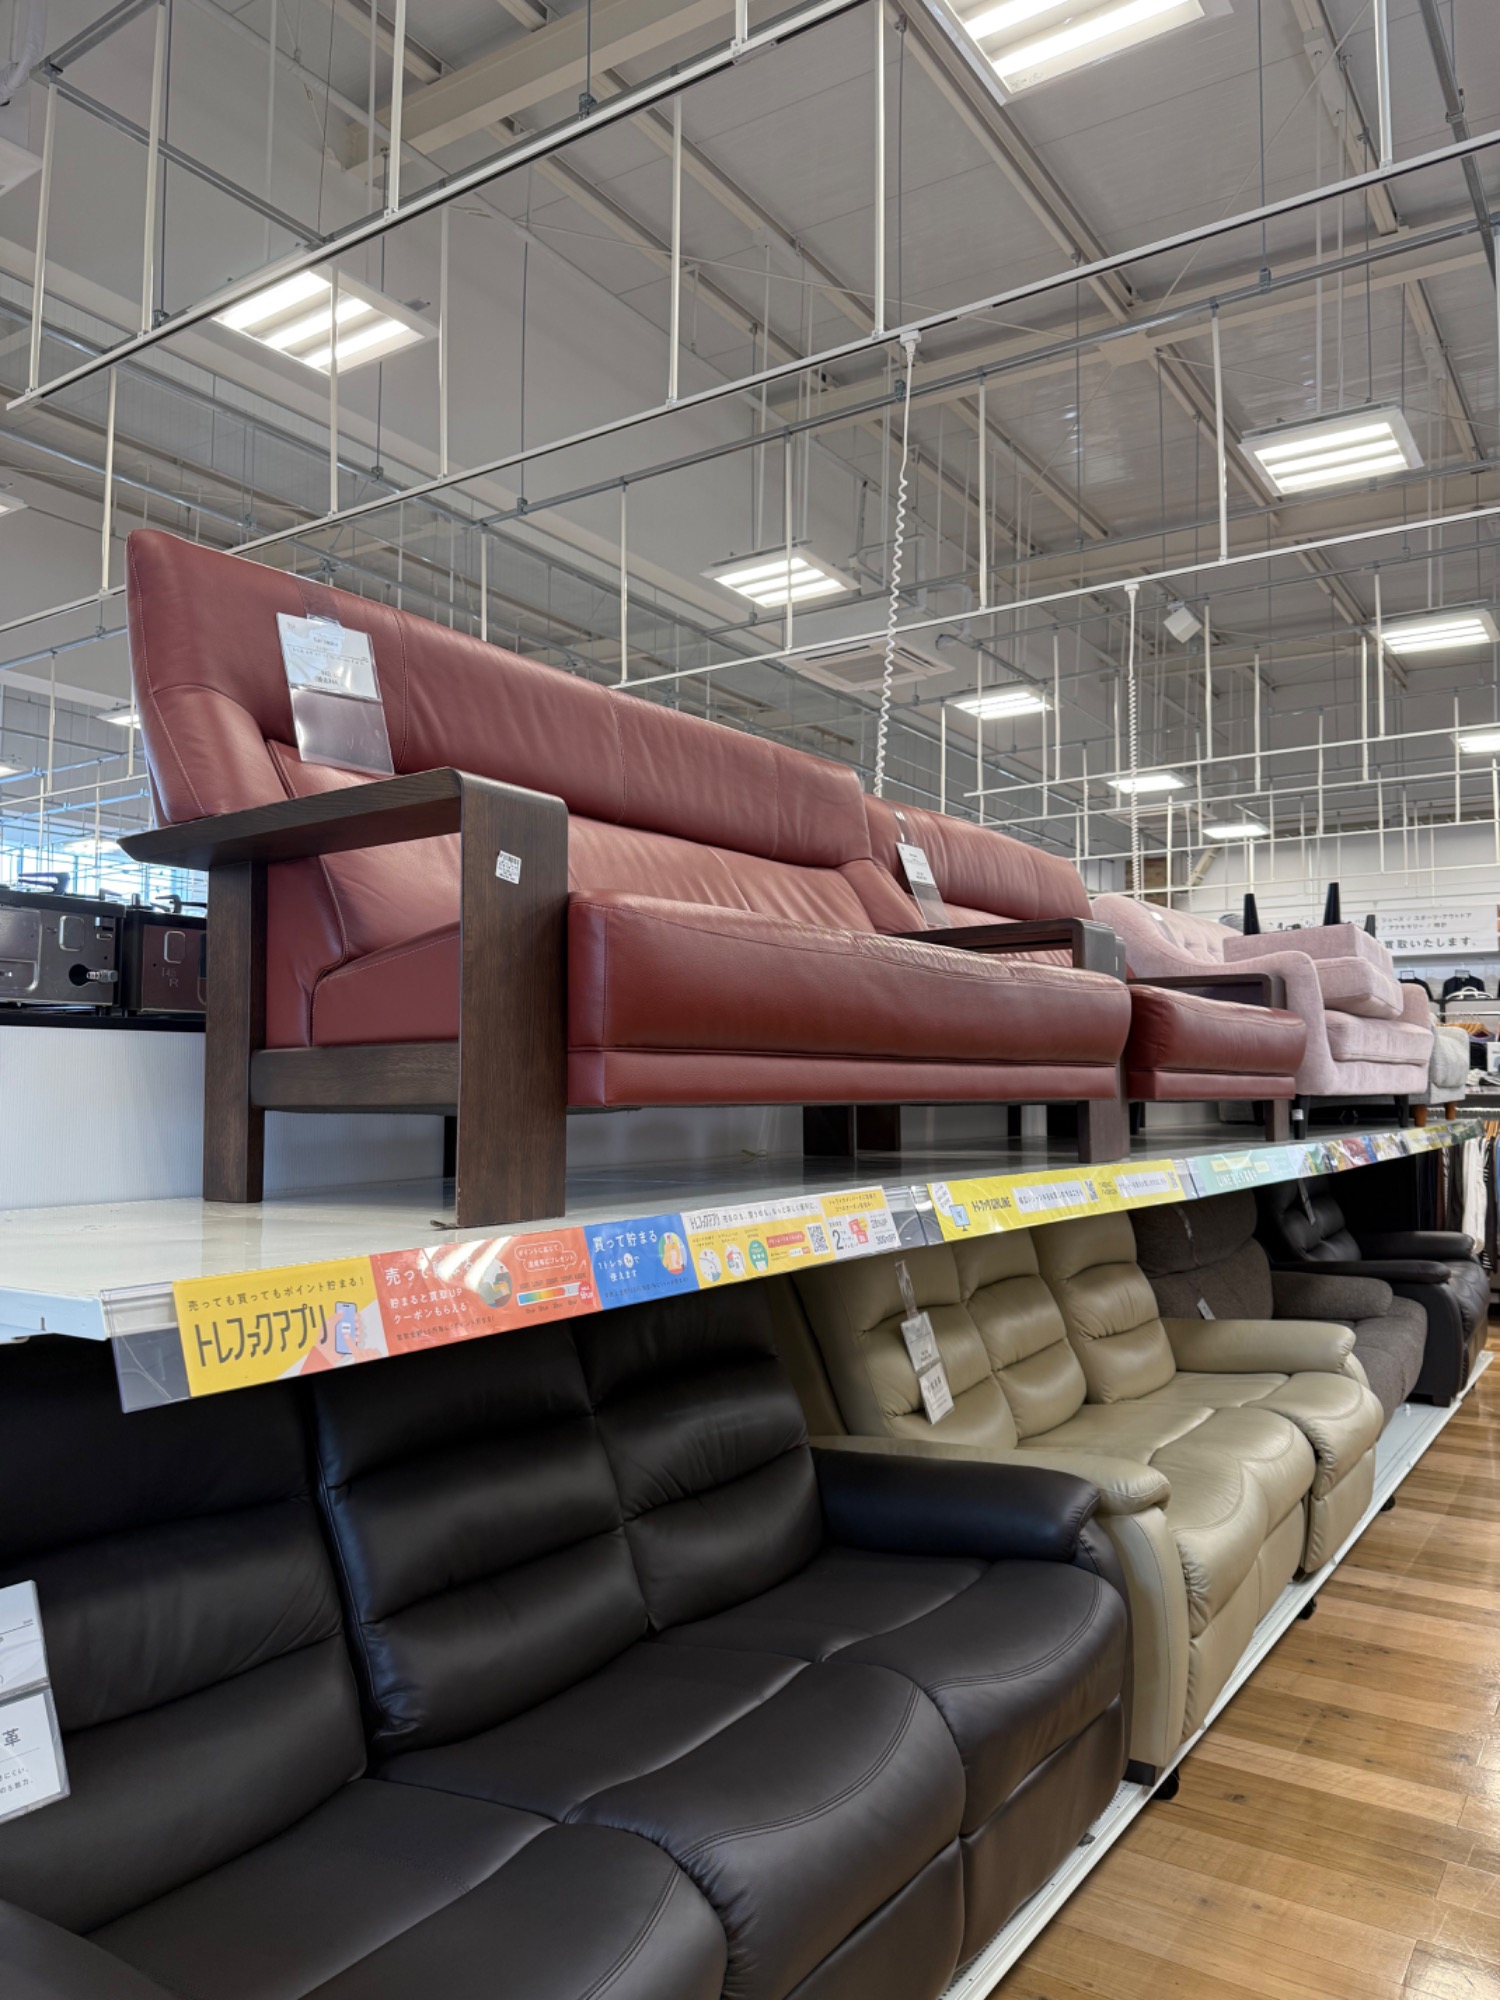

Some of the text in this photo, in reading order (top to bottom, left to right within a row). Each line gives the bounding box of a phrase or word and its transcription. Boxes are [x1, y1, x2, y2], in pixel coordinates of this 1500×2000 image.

[1384, 936, 1476, 950] 買取いたします。
[592, 1230, 658, 1253] 買って貯まる
[187, 1277, 365, 1312] 売っても買ってもポイント貯まる!
[393, 1302, 468, 1325] クーポンもらえる
[194, 1303, 328, 1368] トレファクアプリ
[2, 1728, 21, 1747] 革
